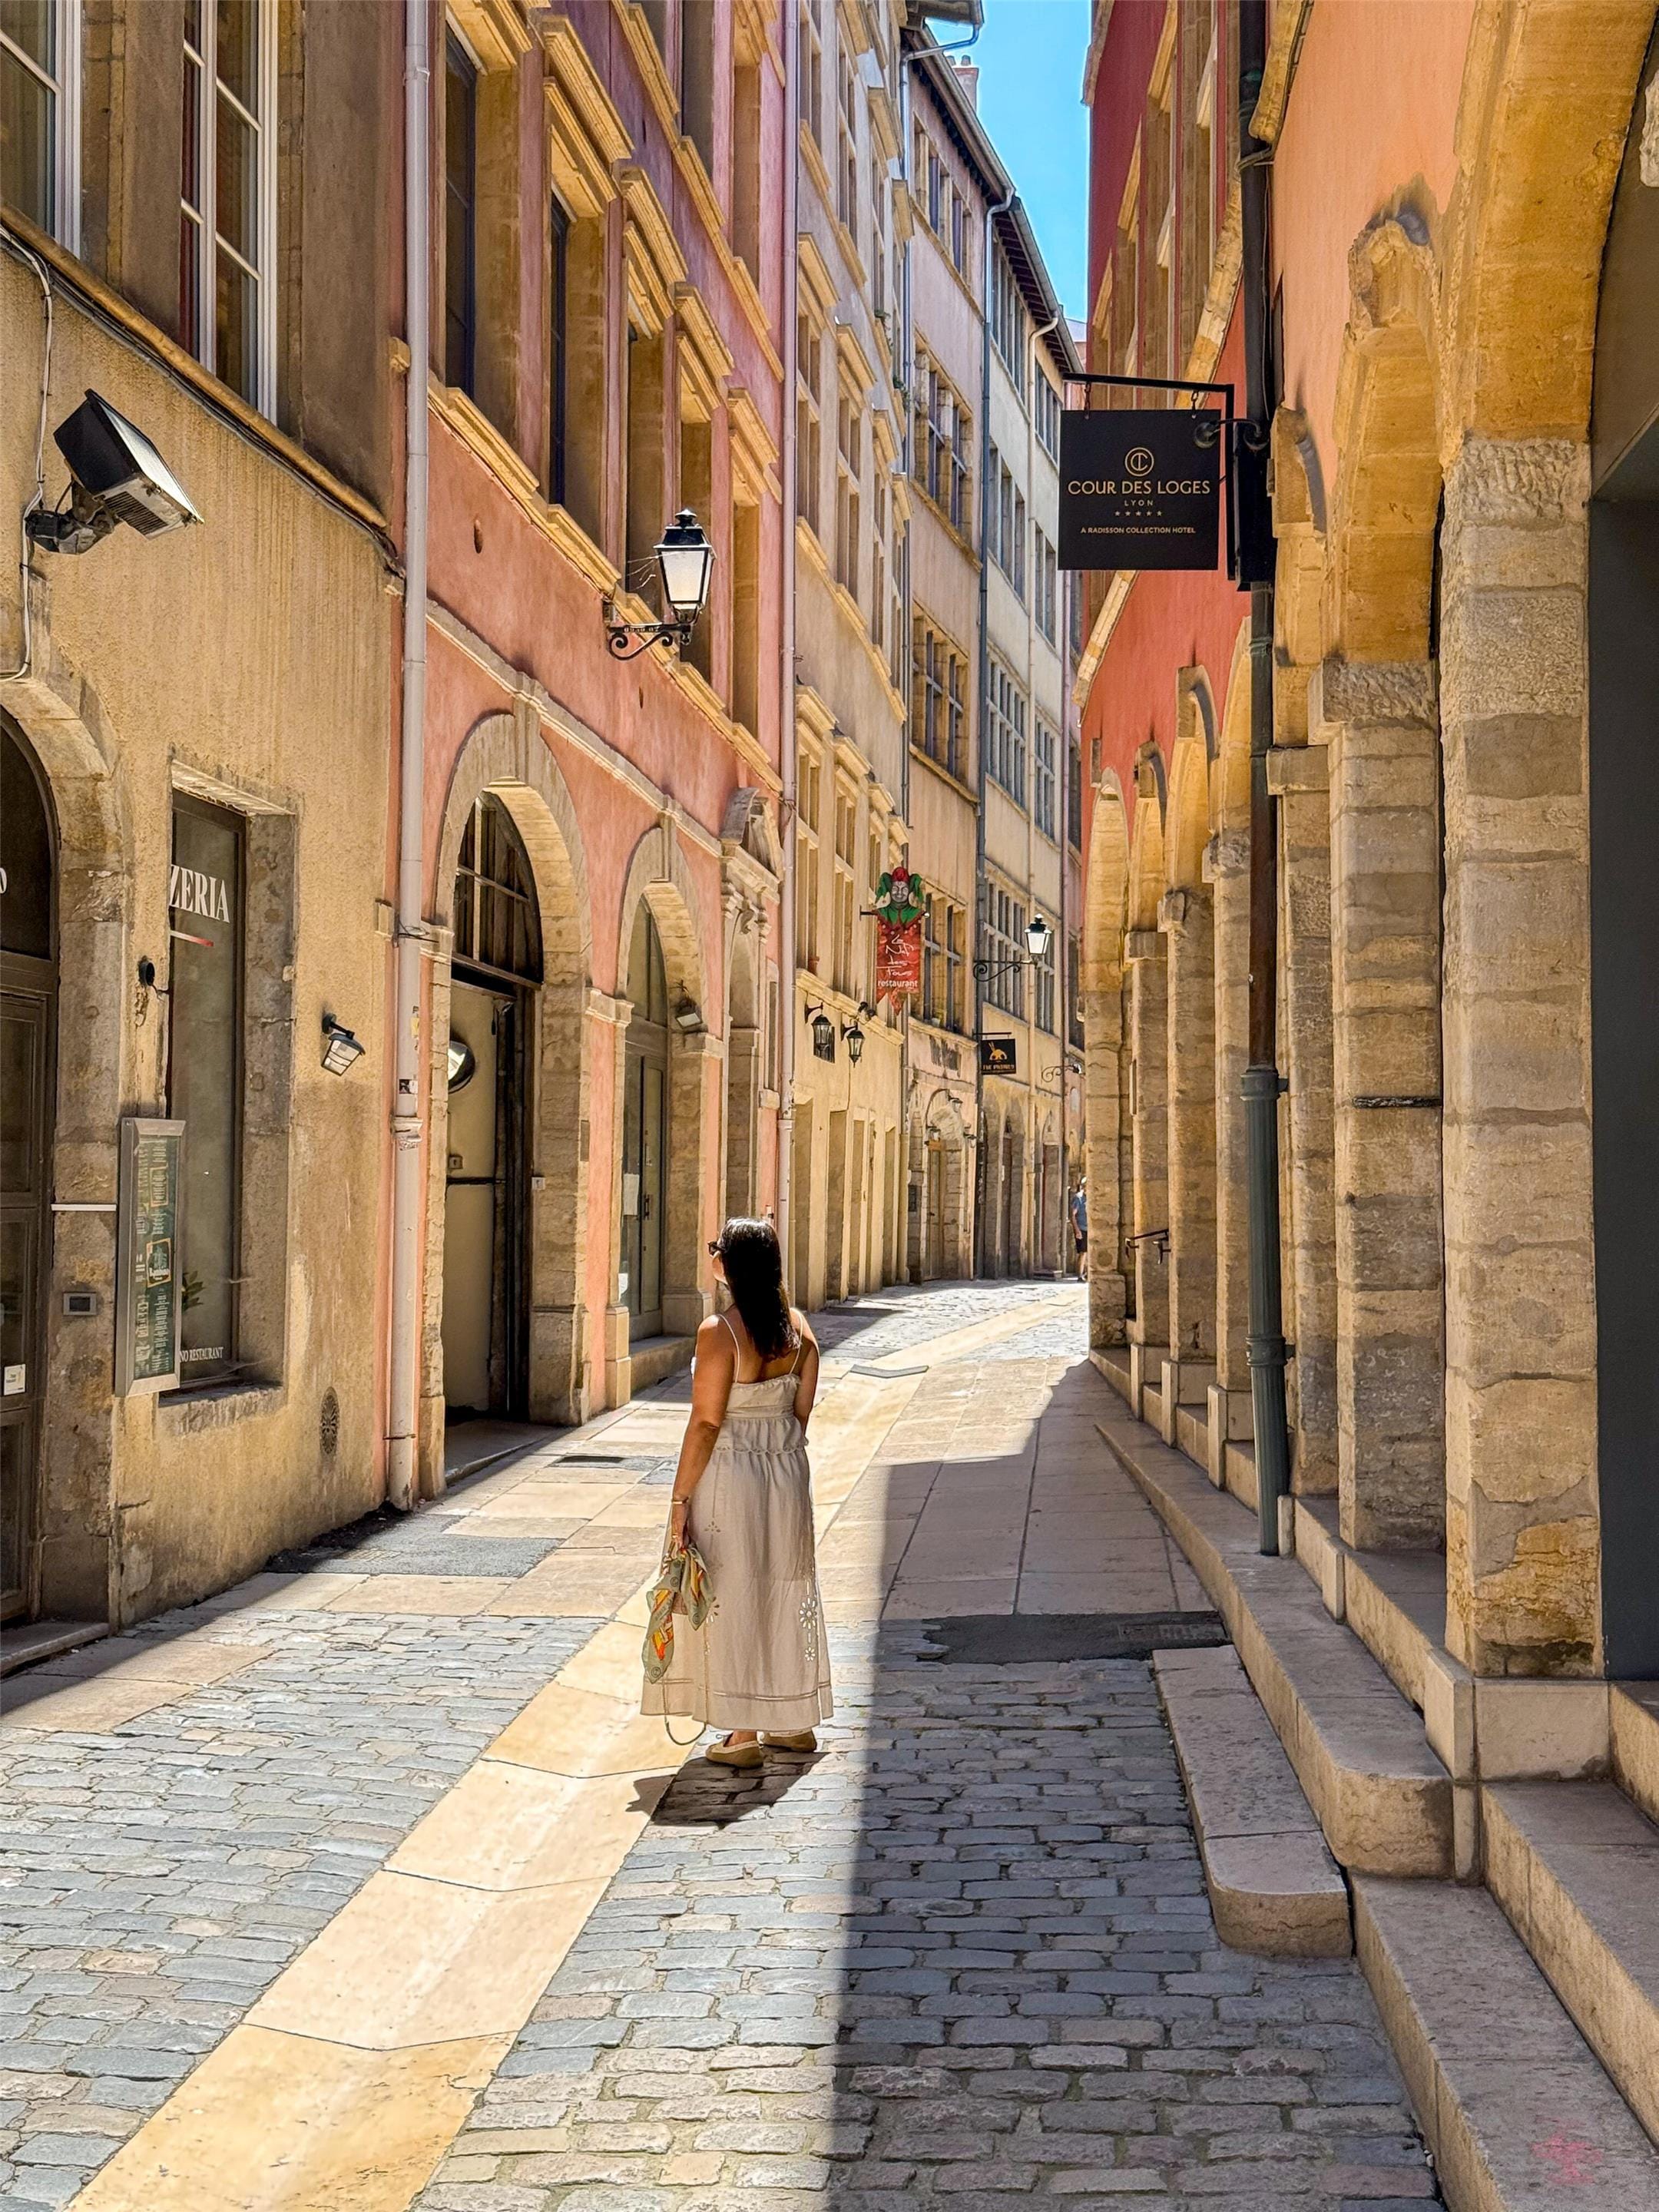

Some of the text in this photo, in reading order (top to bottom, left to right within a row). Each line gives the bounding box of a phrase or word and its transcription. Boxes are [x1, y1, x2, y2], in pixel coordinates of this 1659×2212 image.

[1068, 481, 1210, 495] COUR DES LOGES
